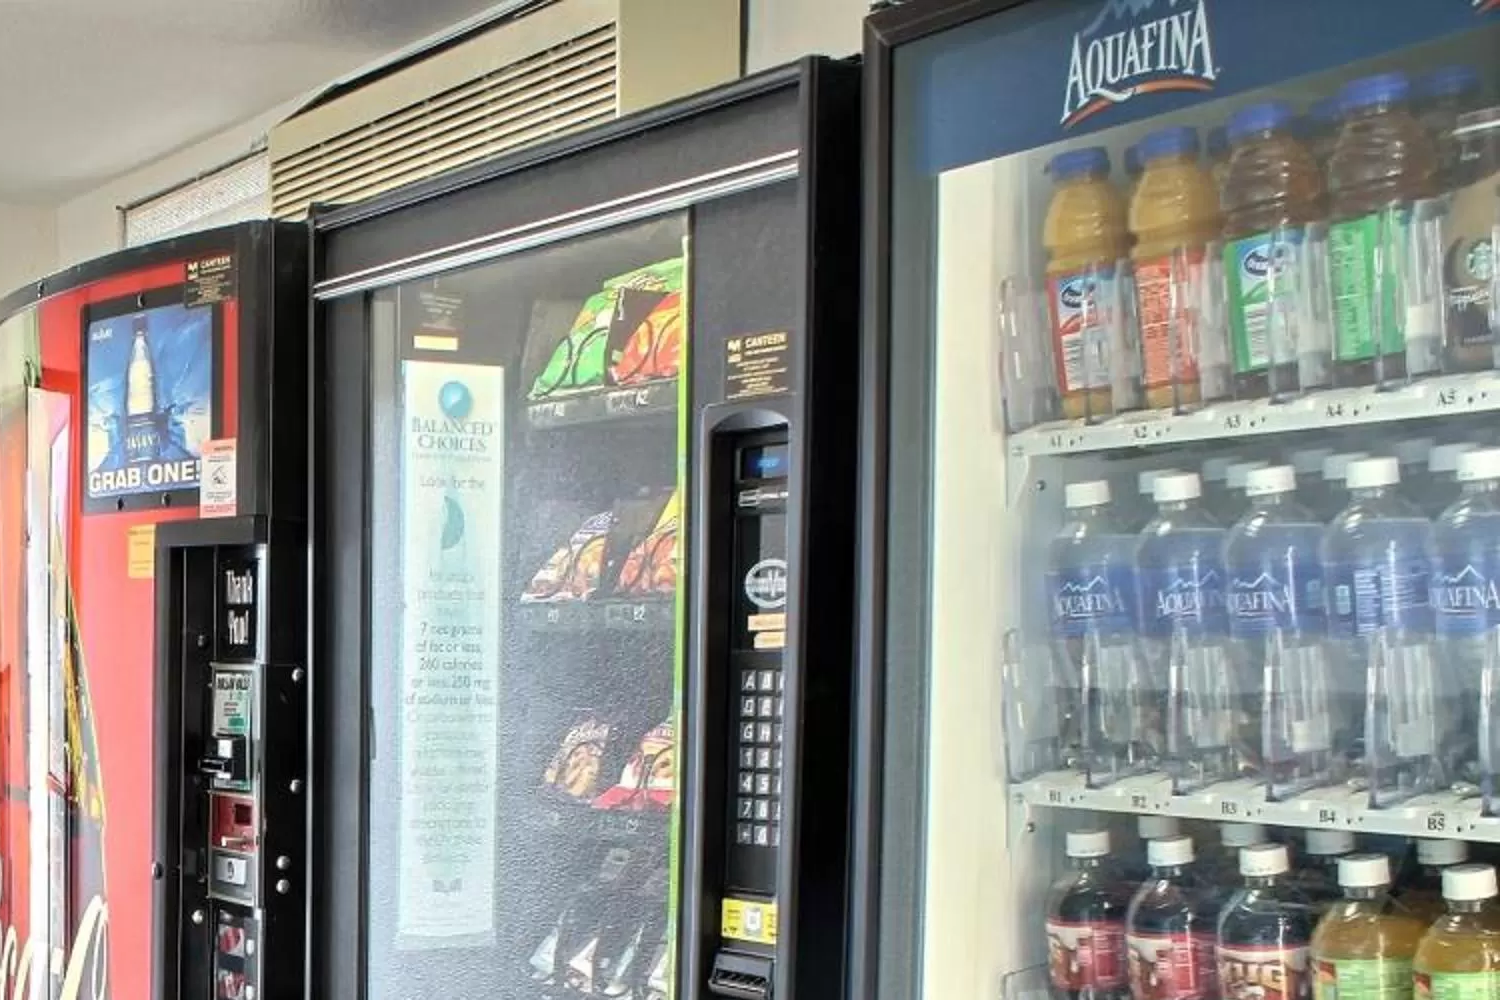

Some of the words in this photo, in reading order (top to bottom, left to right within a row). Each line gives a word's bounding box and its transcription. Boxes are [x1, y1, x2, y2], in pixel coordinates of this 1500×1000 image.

[1060, 0, 1216, 124] AQUAFINA
[1325, 403, 1343, 417] A4
[411, 416, 493, 437] BALANCED
[418, 434, 487, 453] CHOICES
[88, 467, 141, 493] GRAB
[147, 459, 201, 485] ONE!
[225, 568, 254, 605] Thank
[745, 673, 755, 690] A
[743, 723, 753, 740] G
[742, 775, 753, 792] 4
[759, 776, 770, 792] 5
[742, 800, 753, 817] 7
[1221, 800, 1237, 816] B3
[1319, 809, 1336, 823] B4
[1427, 815, 1445, 831] B5
